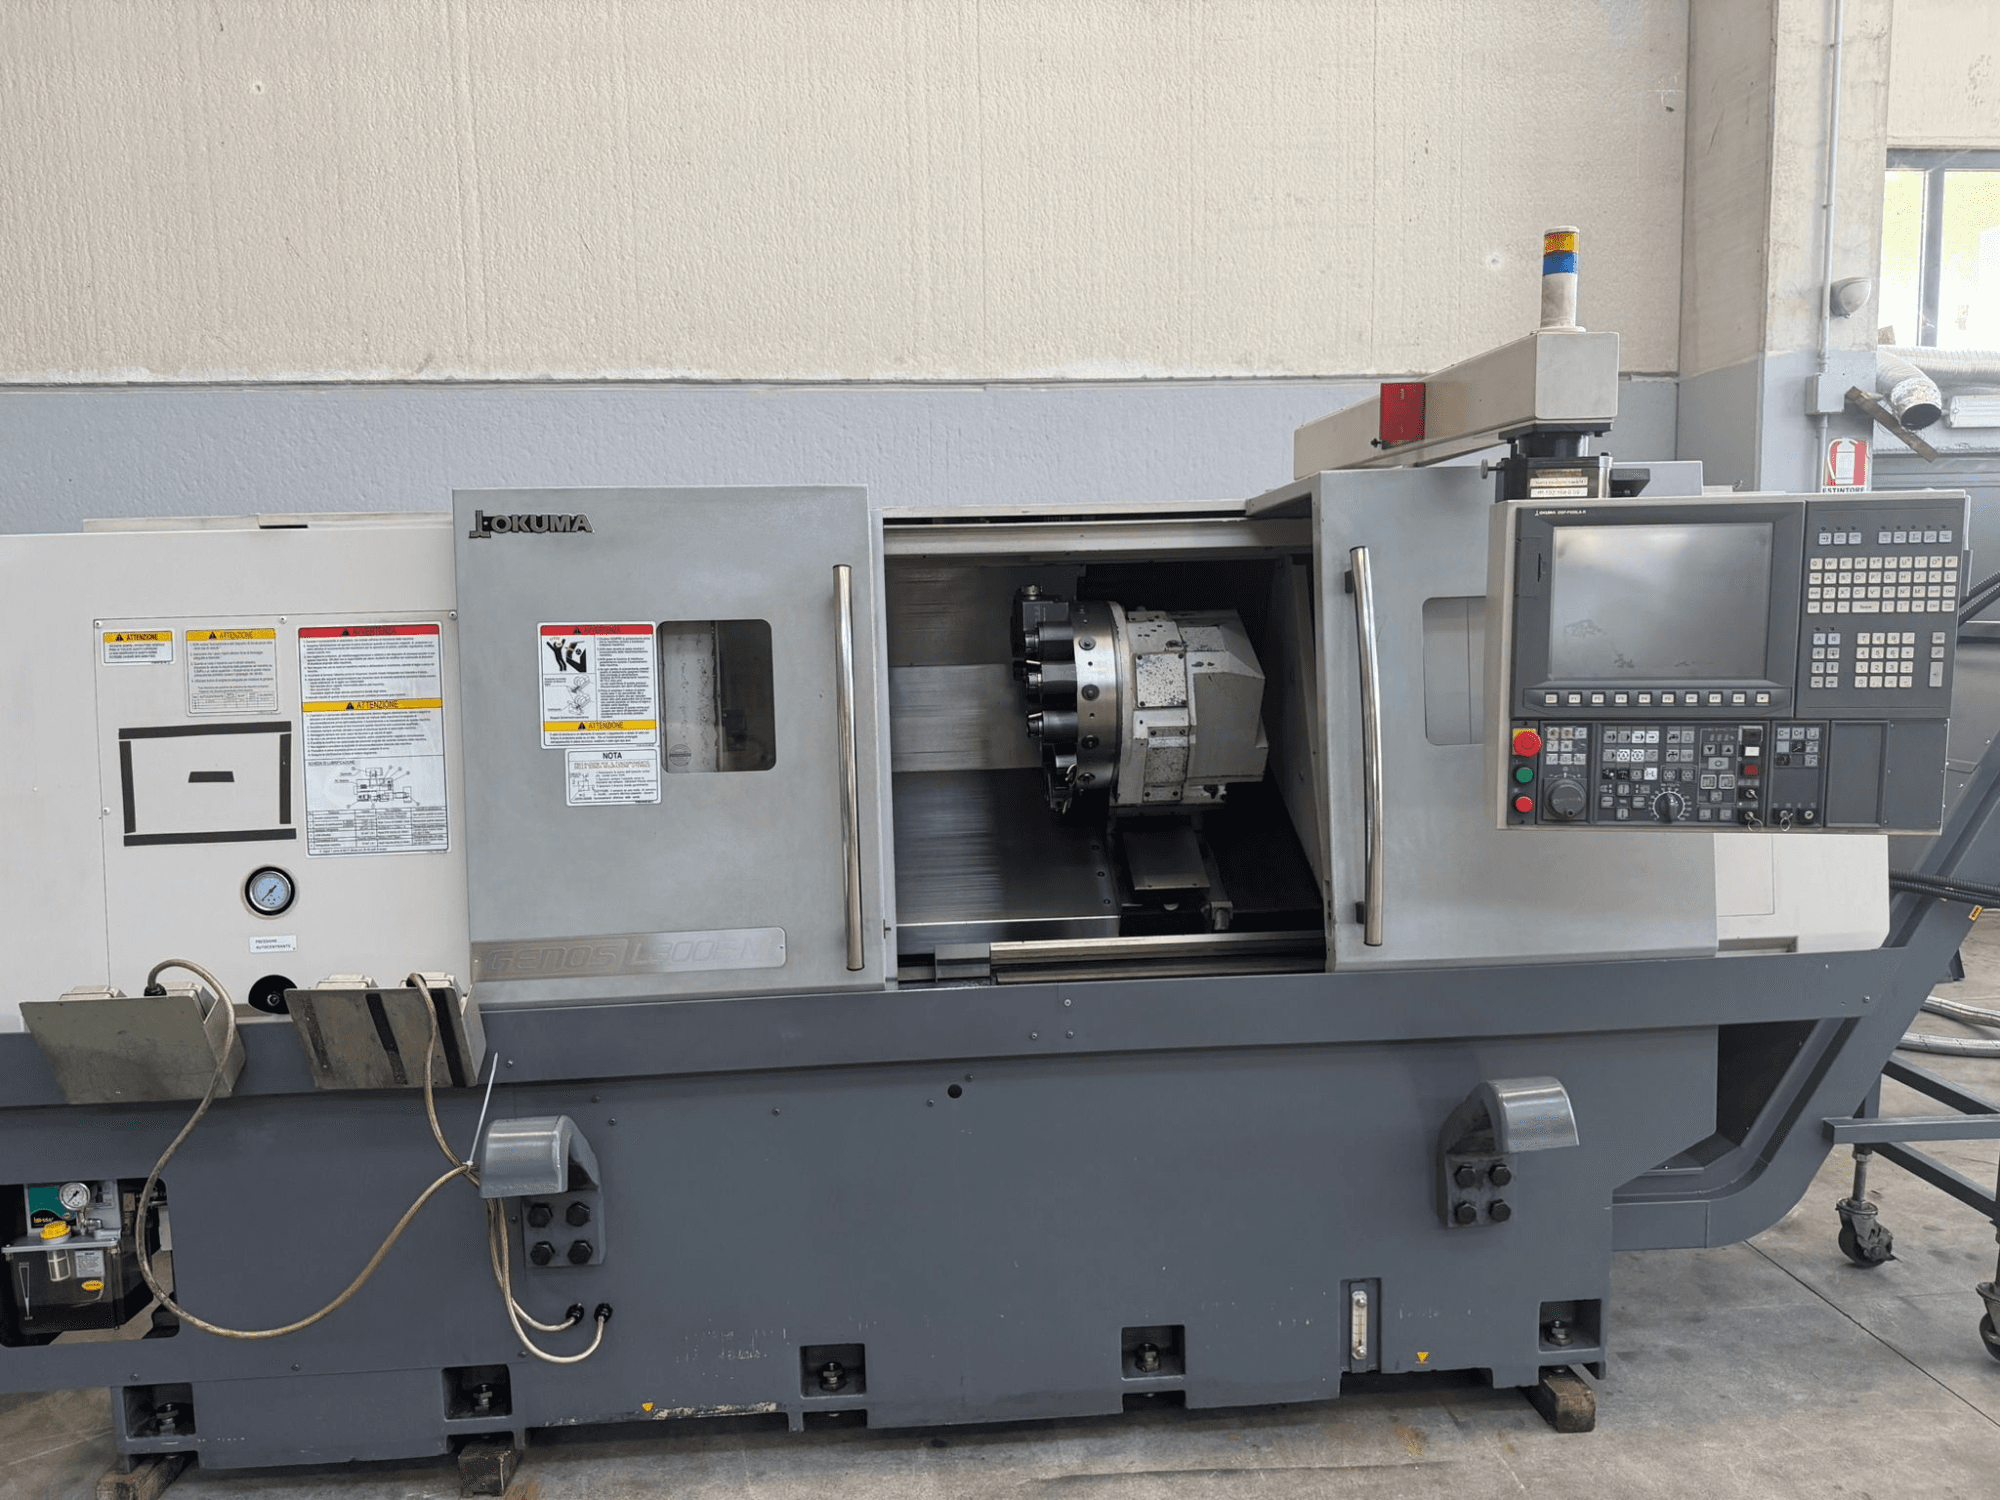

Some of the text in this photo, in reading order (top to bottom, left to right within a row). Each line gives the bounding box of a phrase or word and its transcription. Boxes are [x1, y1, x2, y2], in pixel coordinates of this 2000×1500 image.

[490, 514, 595, 534] OKUMA
[352, 627, 397, 636] AVVERTENZA
[583, 625, 621, 634] AVVERTENZA
[127, 633, 158, 641] ATTENZIONE
[219, 631, 253, 640] ATTENZIONE
[356, 701, 398, 710] ATTENZIONE
[588, 721, 624, 730] ATTENZIONE
[602, 752, 622, 760] NOTA
[490, 945, 622, 970] GENOS
